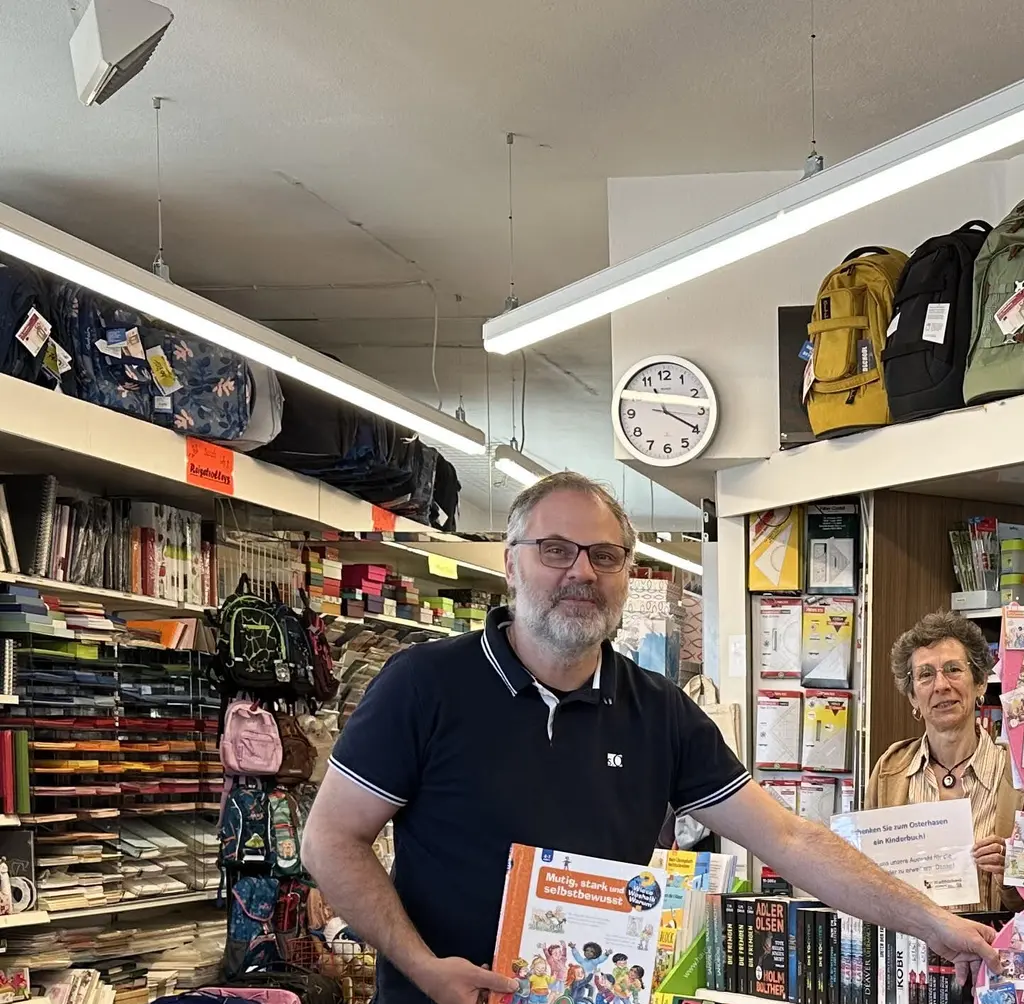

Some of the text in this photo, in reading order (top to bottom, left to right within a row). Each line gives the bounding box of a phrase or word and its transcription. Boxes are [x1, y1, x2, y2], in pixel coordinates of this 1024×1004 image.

[658, 370, 672, 381] 12
[679, 374, 684, 385] 1
[642, 376, 652, 387] 11
[690, 388, 700, 398] 2
[627, 409, 636, 419] 9
[633, 427, 643, 437] 8
[646, 440, 655, 450] 7
[663, 443, 672, 454] 6
[681, 438, 690, 448] 5
[909, 818, 948, 828] Osterhasen
[545, 872, 625, 894] Mutig, stark und
[543, 884, 624, 906] selbstbewusst
[756, 902, 784, 918] ADLER
[755, 918, 784, 933] OLSEN
[896, 950, 904, 988] KOBR
[763, 971, 785, 984] HOLM
